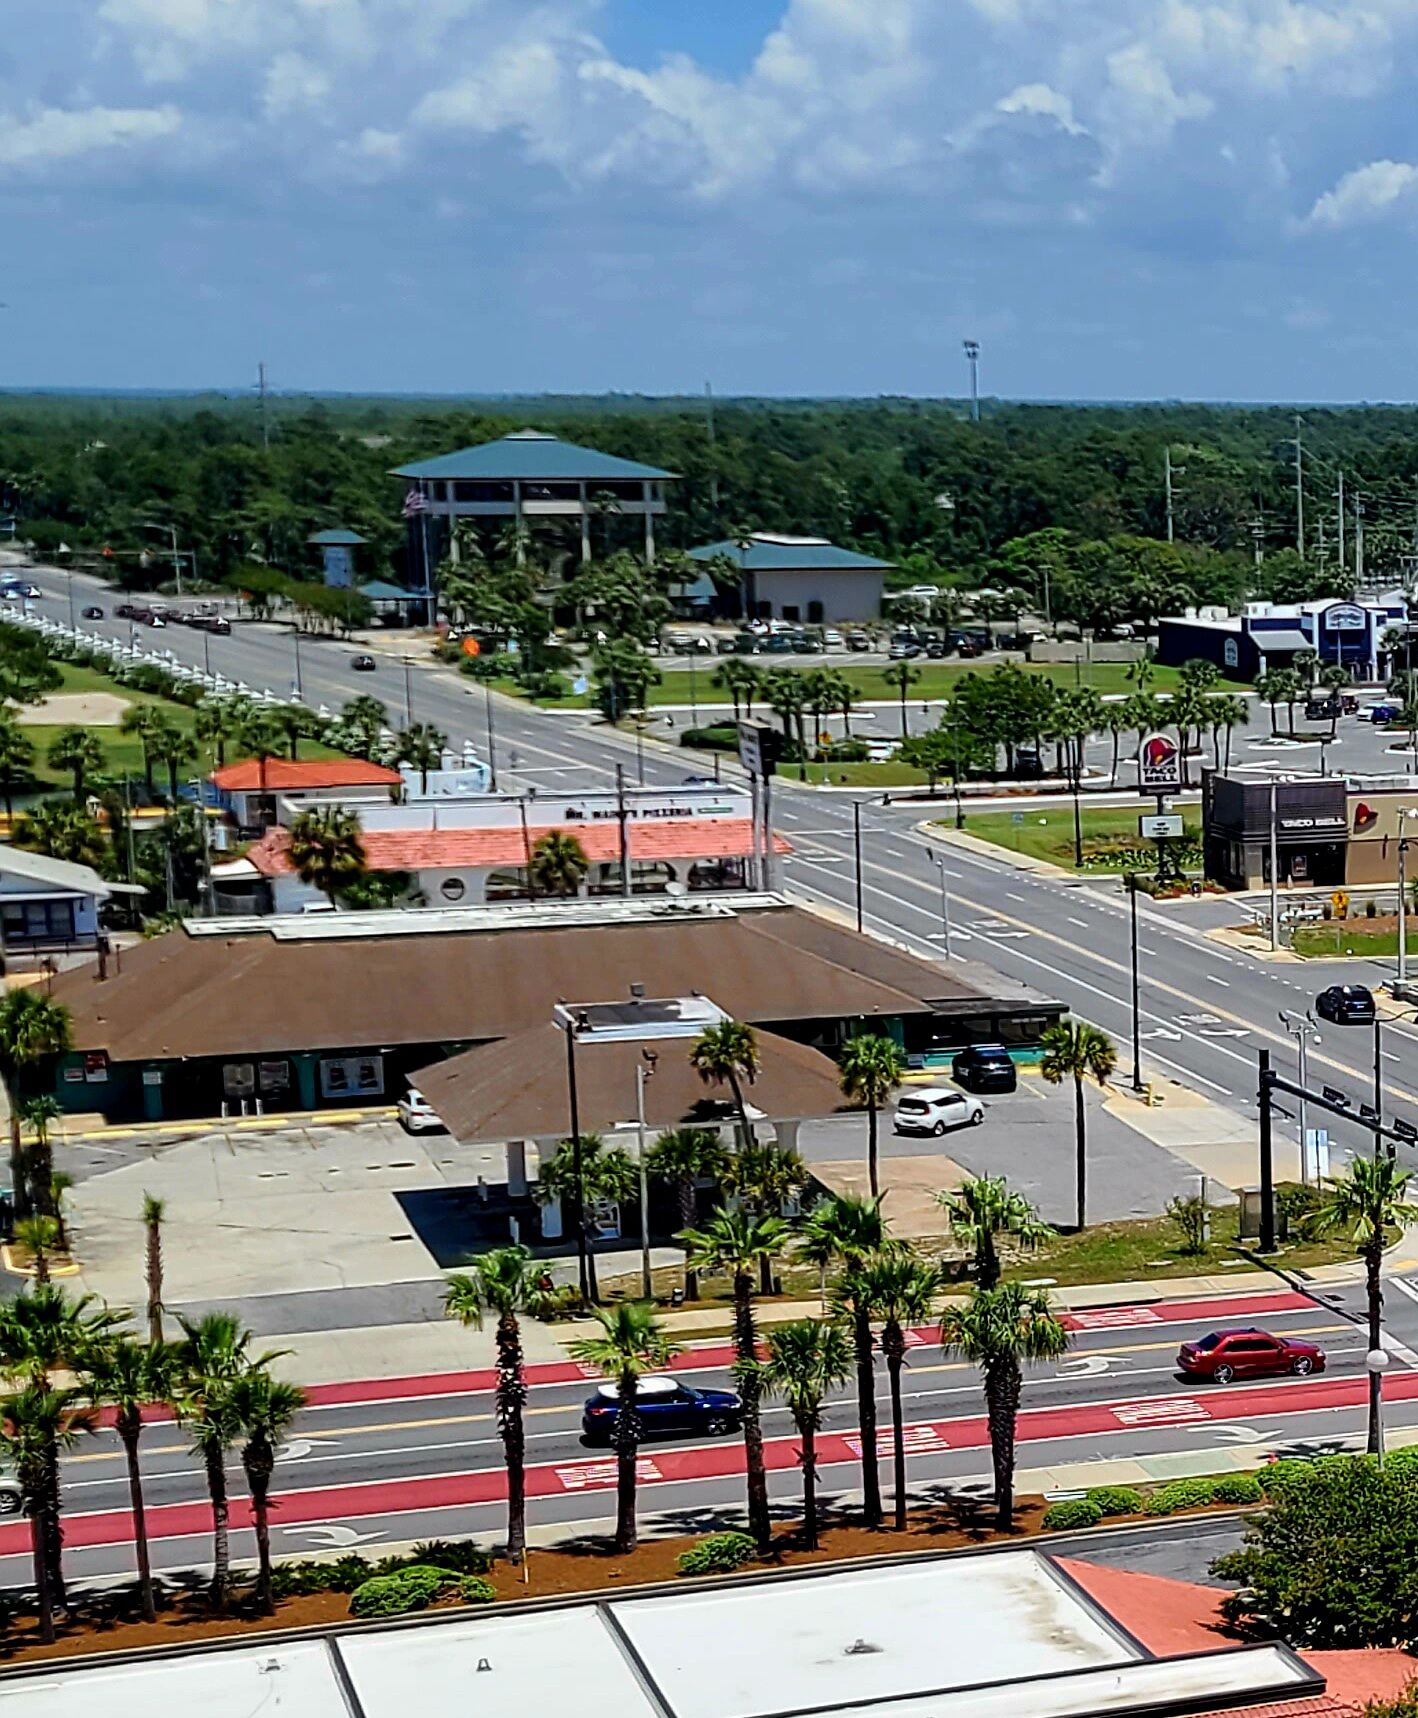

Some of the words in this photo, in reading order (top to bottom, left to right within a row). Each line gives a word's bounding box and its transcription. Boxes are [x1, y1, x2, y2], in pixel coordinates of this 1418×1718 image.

[1143, 766, 1177, 775] TACO
[1144, 775, 1178, 783] BELL
[1281, 819, 1314, 828] TACO
[1315, 818, 1346, 826] BELL
